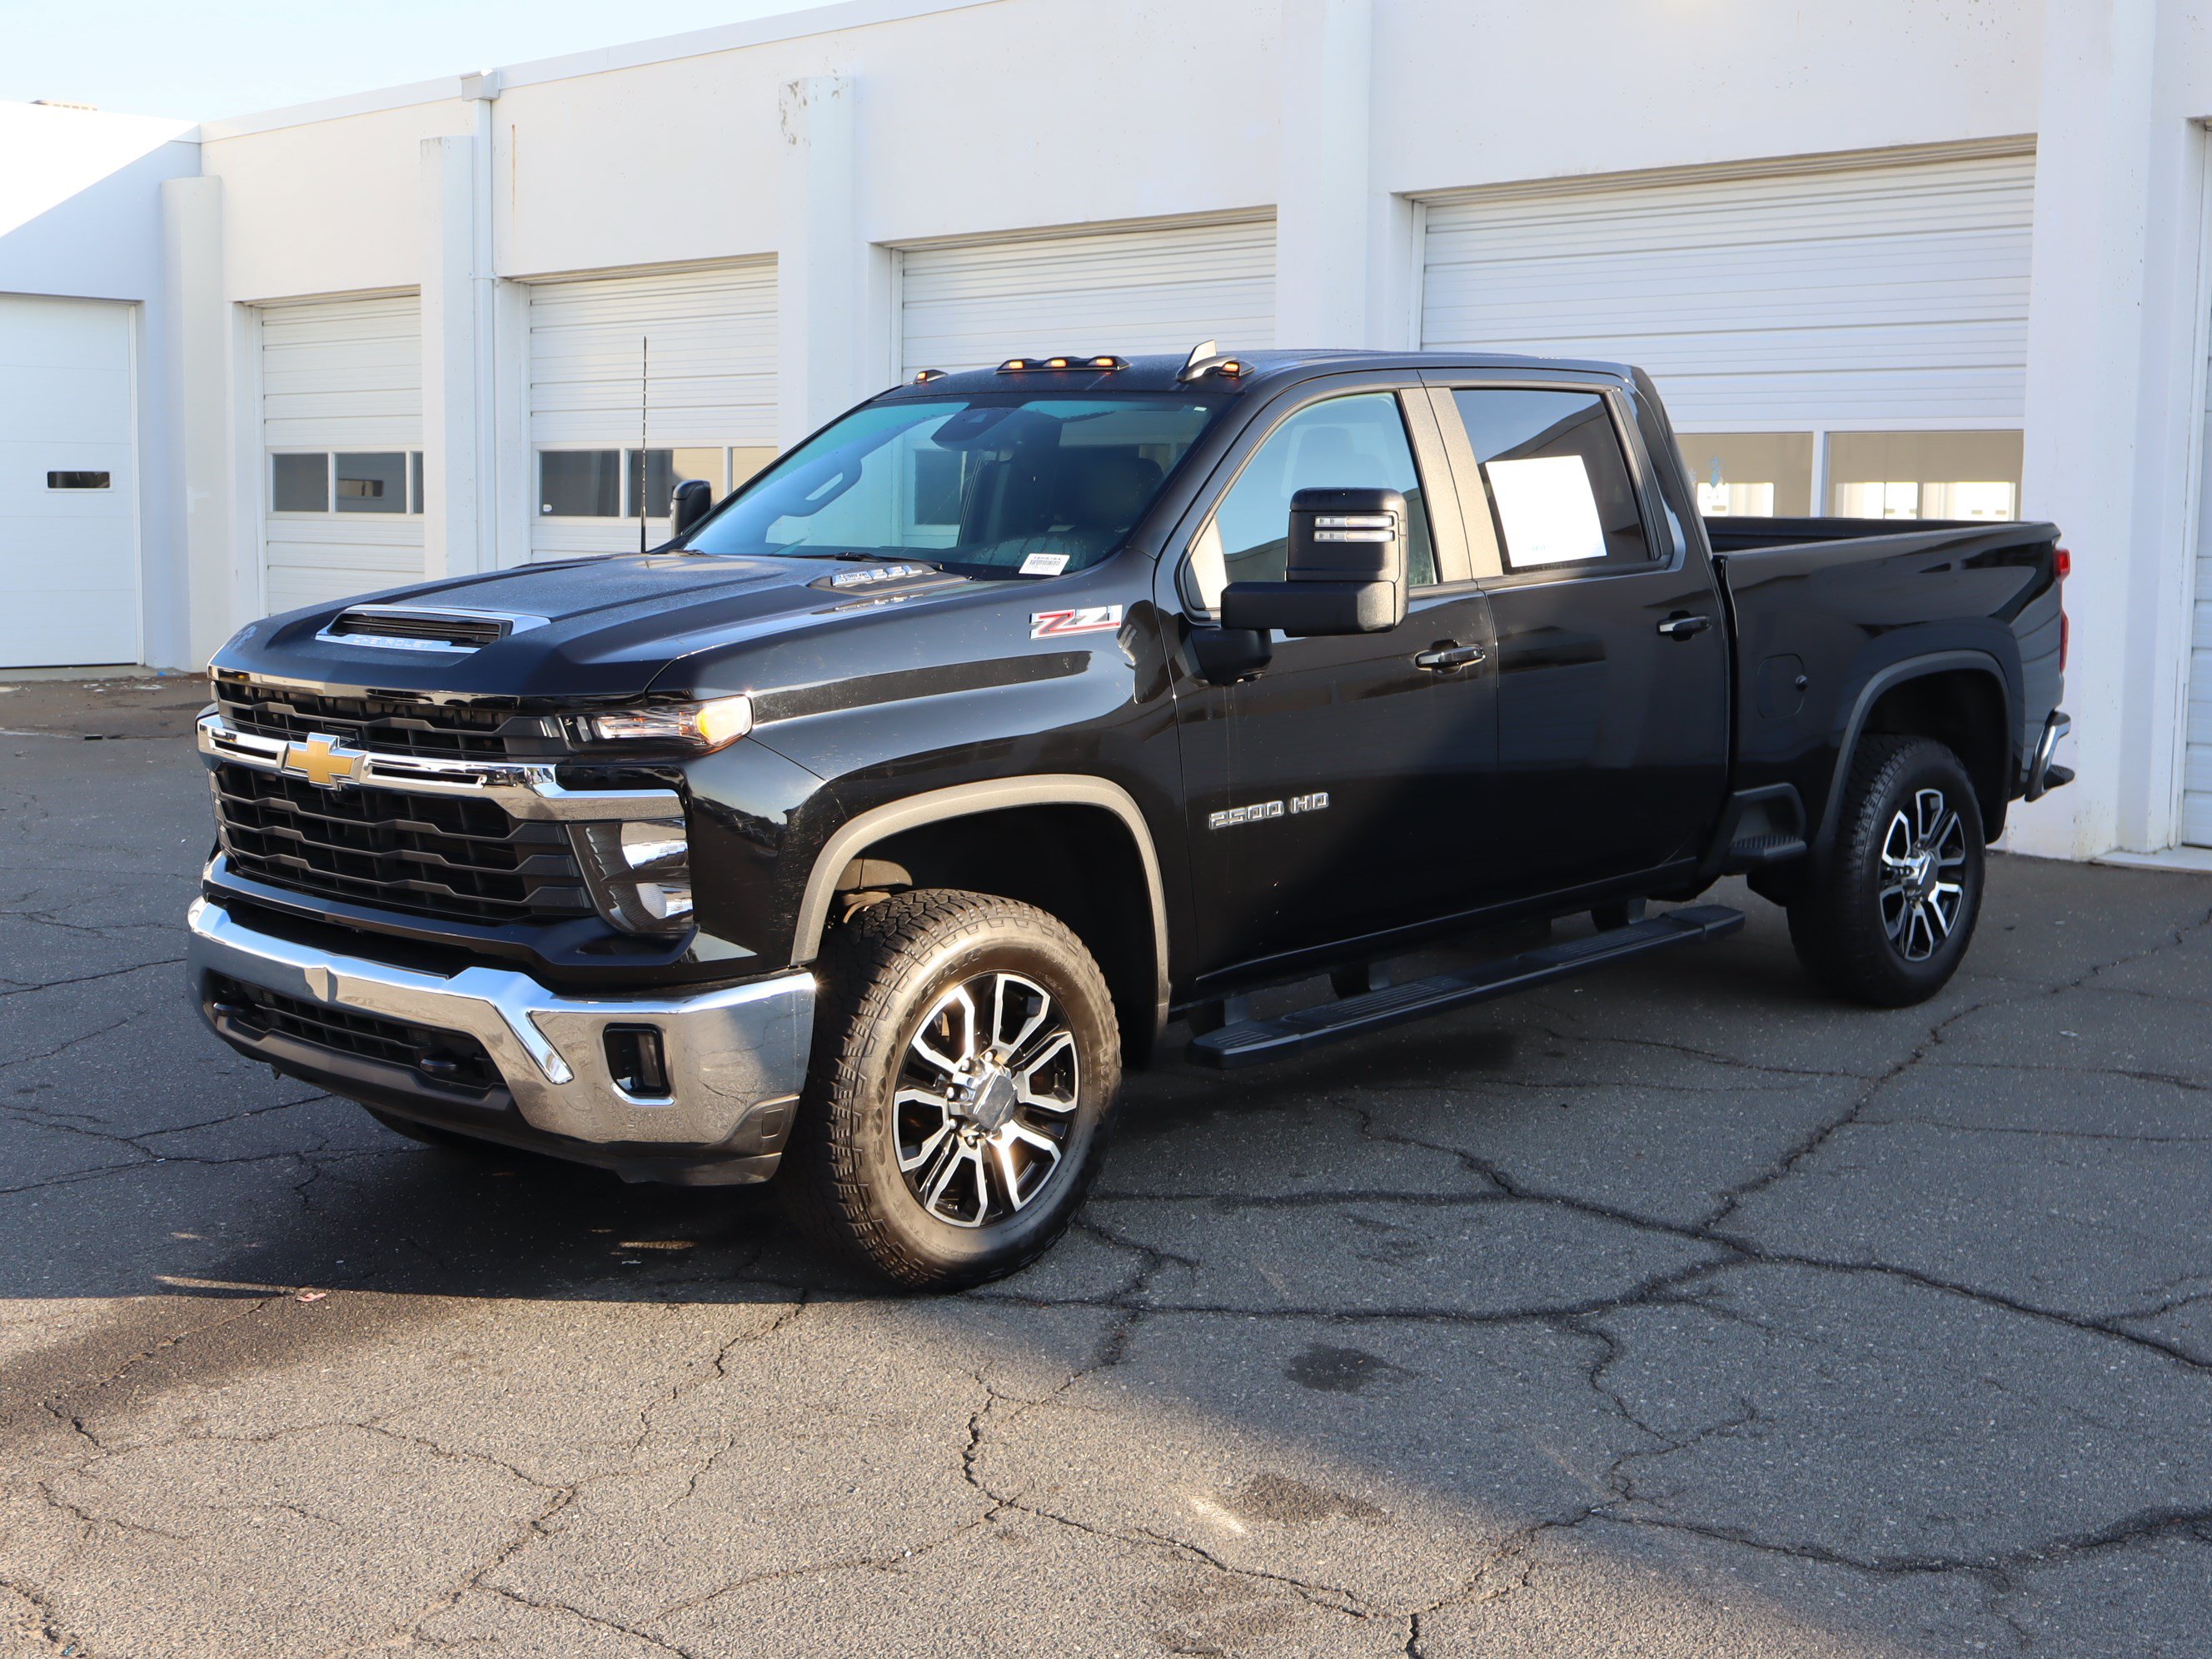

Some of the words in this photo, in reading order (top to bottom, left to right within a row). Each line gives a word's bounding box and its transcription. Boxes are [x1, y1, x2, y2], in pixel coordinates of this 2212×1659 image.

[1029, 605, 1123, 640] Z71
[353, 635, 432, 648] CHEVROLET
[1209, 800, 1285, 830] 2500
[1291, 792, 1329, 814] HD
